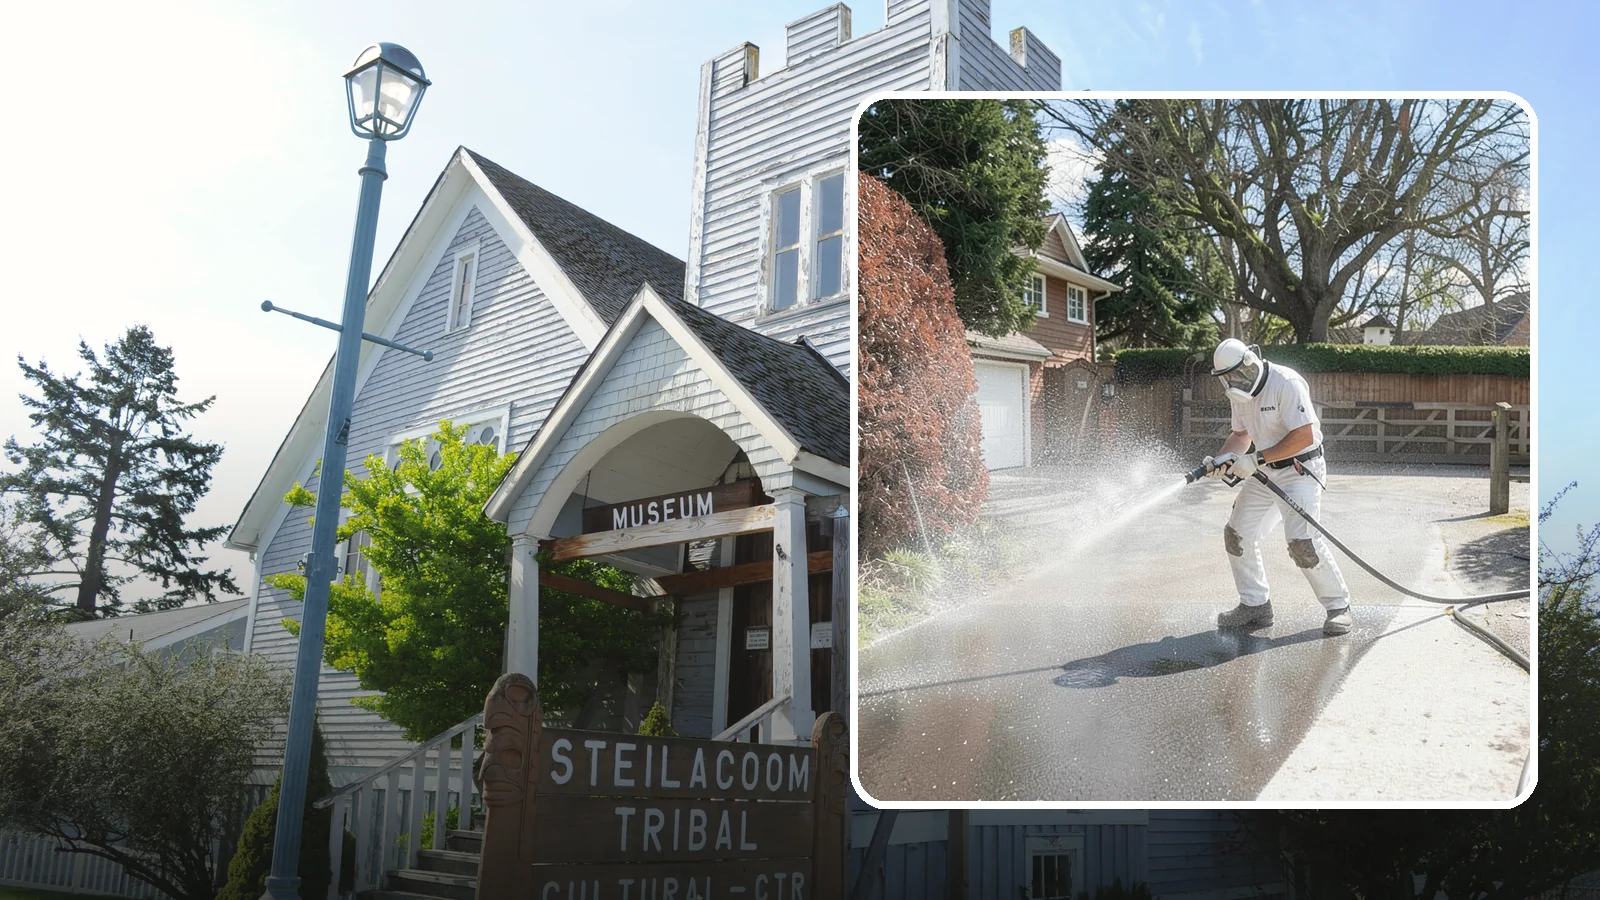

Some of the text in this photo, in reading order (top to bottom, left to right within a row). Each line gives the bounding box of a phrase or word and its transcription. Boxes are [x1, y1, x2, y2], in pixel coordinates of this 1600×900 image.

[612, 491, 713, 531] MUSEUM
[550, 738, 809, 793] STEILACOOM
[615, 806, 757, 852] TRIBAL
